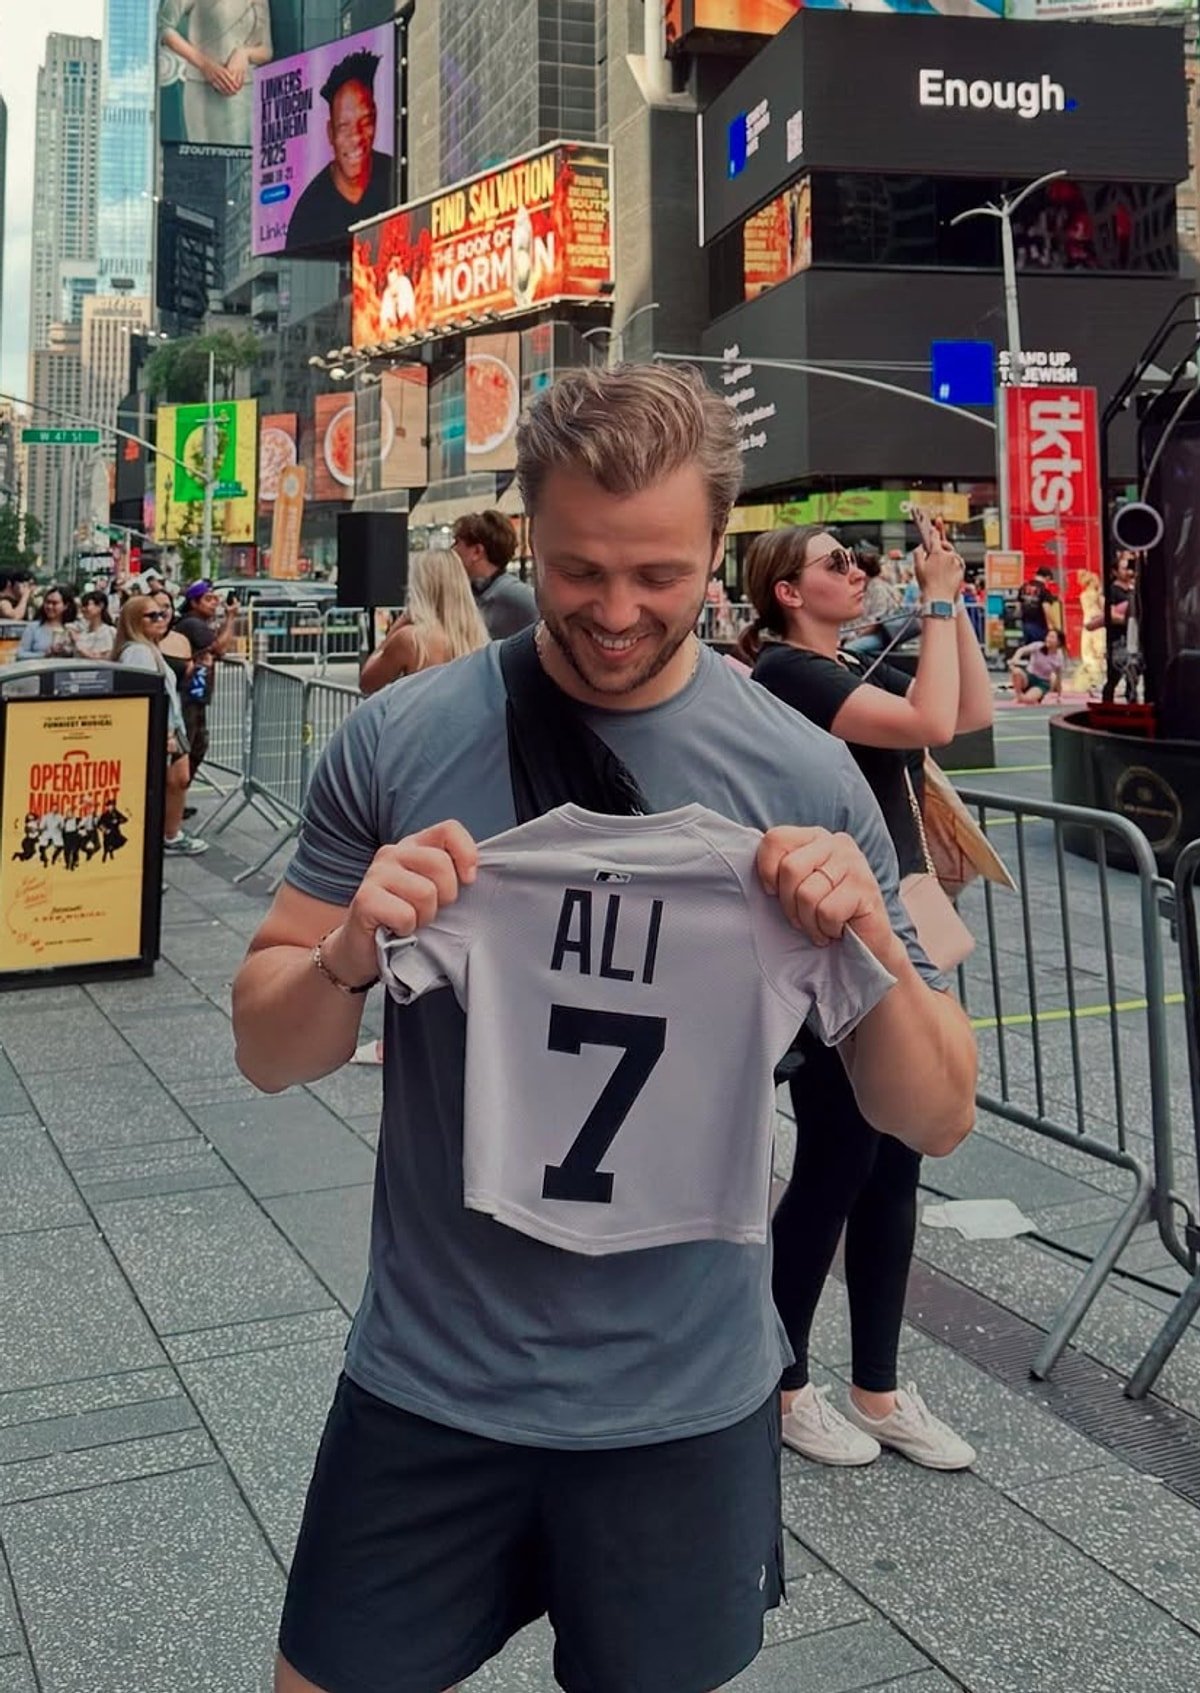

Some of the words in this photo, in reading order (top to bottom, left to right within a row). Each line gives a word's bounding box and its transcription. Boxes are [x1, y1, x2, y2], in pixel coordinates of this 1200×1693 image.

[261, 101, 272, 123] AT
[919, 69, 1079, 119] Enough.
[261, 141, 286, 169] 2025
[431, 190, 465, 239] FIND
[469, 154, 555, 225] SALVATION
[432, 243, 454, 266] THE
[457, 233, 491, 261] BOOK
[493, 226, 511, 248] OF
[432, 231, 555, 309] MORMN
[999, 351, 1047, 366] SAND
[1049, 352, 1070, 367] UP
[1022, 367, 1078, 383] JEWISH
[1029, 395, 1084, 513] tkts
[30, 760, 121, 792] OPERATION
[550, 888, 664, 984] ALI
[541, 1004, 667, 1203] 7
